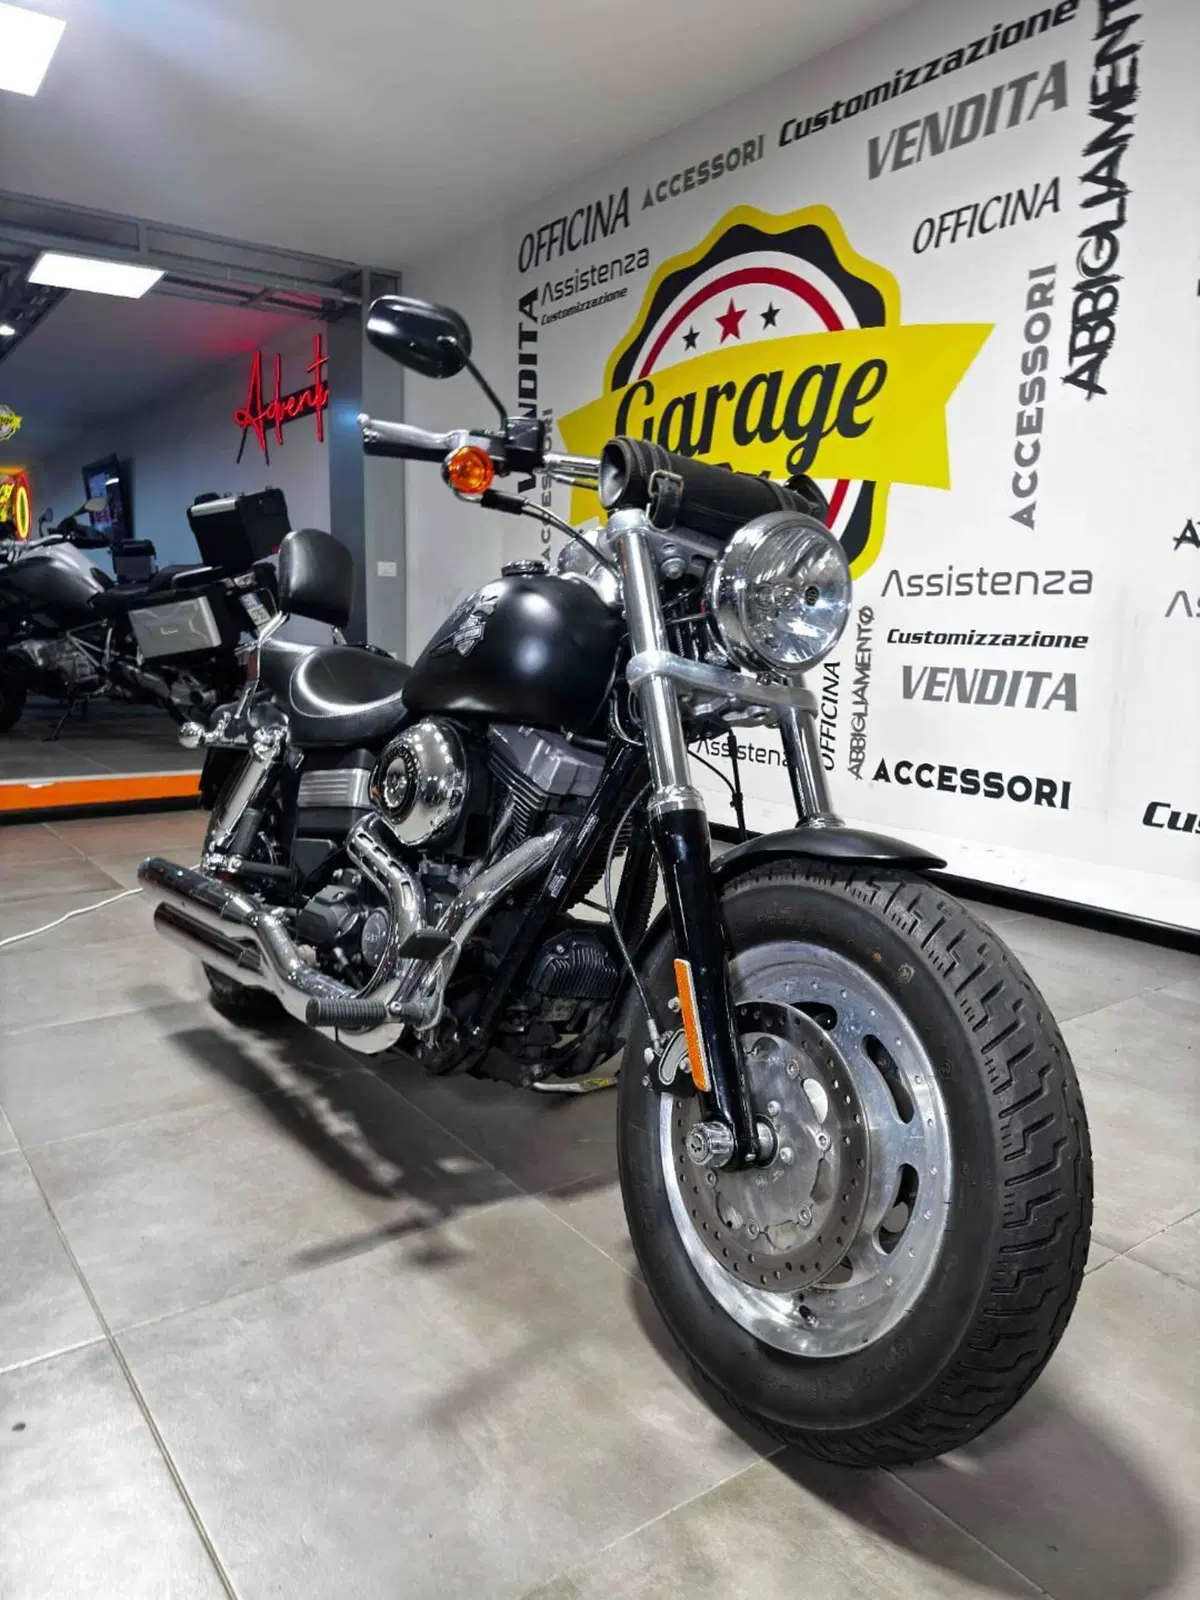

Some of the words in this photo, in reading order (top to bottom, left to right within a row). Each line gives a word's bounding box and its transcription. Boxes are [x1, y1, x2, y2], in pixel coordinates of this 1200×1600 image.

[778, 0, 1079, 147] Customizzazione
[868, 60, 1068, 180] VENDITA
[641, 134, 765, 211] ACCESSORI
[518, 186, 630, 273] OFFICINA
[913, 176, 1060, 254] OFFICINA
[540, 247, 649, 306] Assistenza
[541, 287, 628, 325] Customizzazione
[518, 287, 538, 493] VDITA
[614, 358, 888, 475] Garage
[1009, 263, 1057, 530] ACCESSORI
[881, 565, 1093, 597] Assistenza
[887, 629, 1089, 649] Customizzazione
[902, 665, 1078, 712] VENDITA
[872, 758, 1072, 810] ACCESSORI
